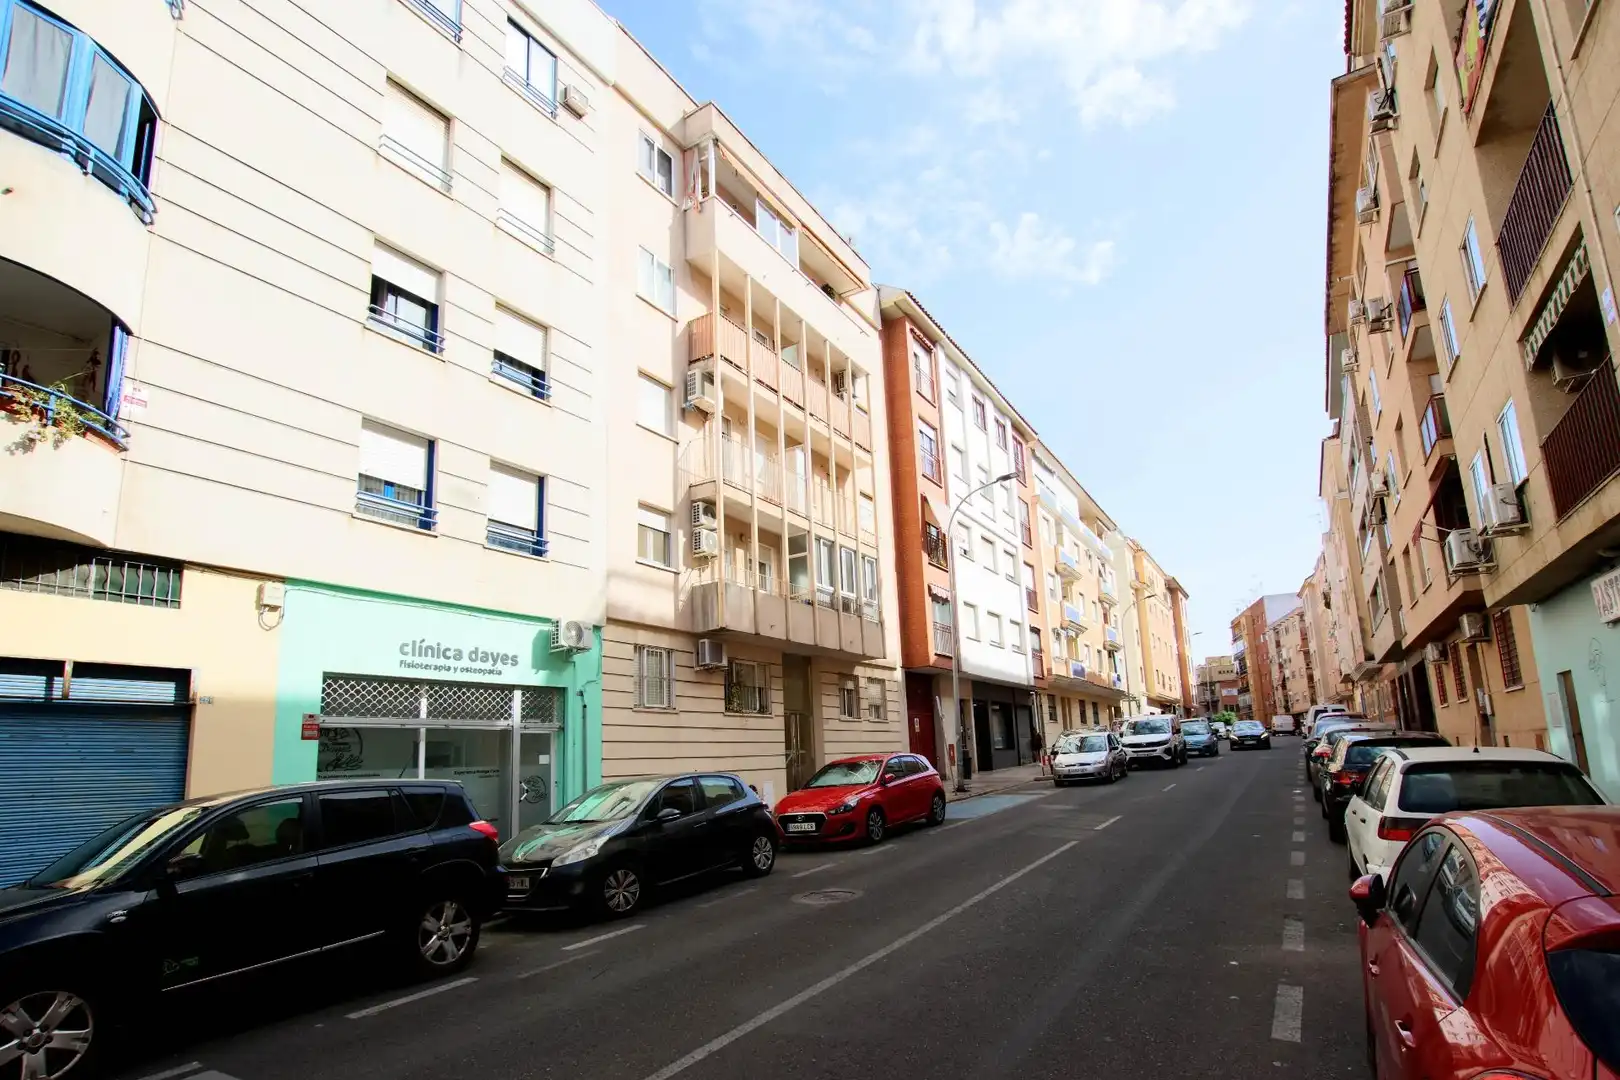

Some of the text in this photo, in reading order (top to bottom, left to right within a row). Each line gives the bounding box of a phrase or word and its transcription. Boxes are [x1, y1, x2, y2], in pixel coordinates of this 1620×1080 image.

[399, 638, 519, 667] clínica dayes
[453, 666, 459, 674] y
